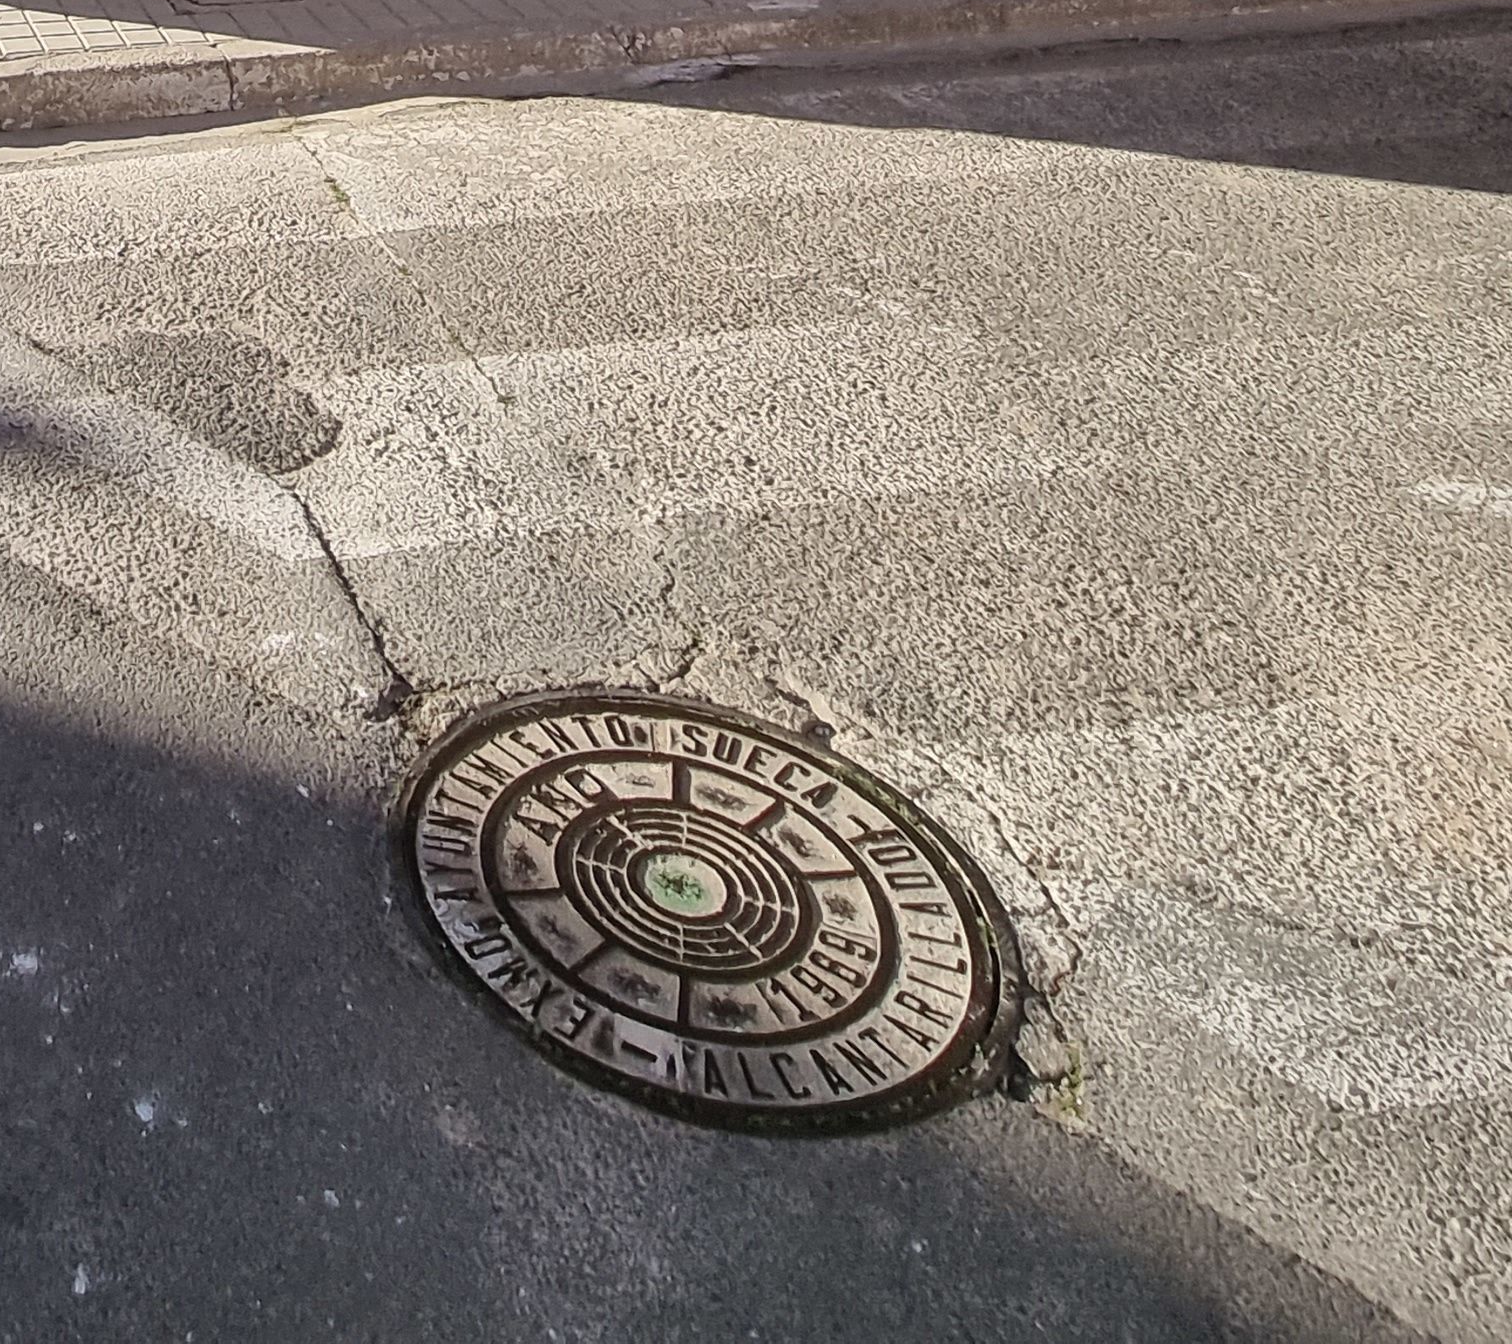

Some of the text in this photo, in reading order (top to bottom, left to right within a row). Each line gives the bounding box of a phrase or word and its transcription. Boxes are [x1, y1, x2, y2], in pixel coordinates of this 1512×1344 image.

[422, 714, 634, 903] AYUNTAMIENTO
[681, 723, 839, 809] SUECA
[703, 844, 970, 1100] ALCANTARILLADO
[769, 929, 879, 1023] 1989
